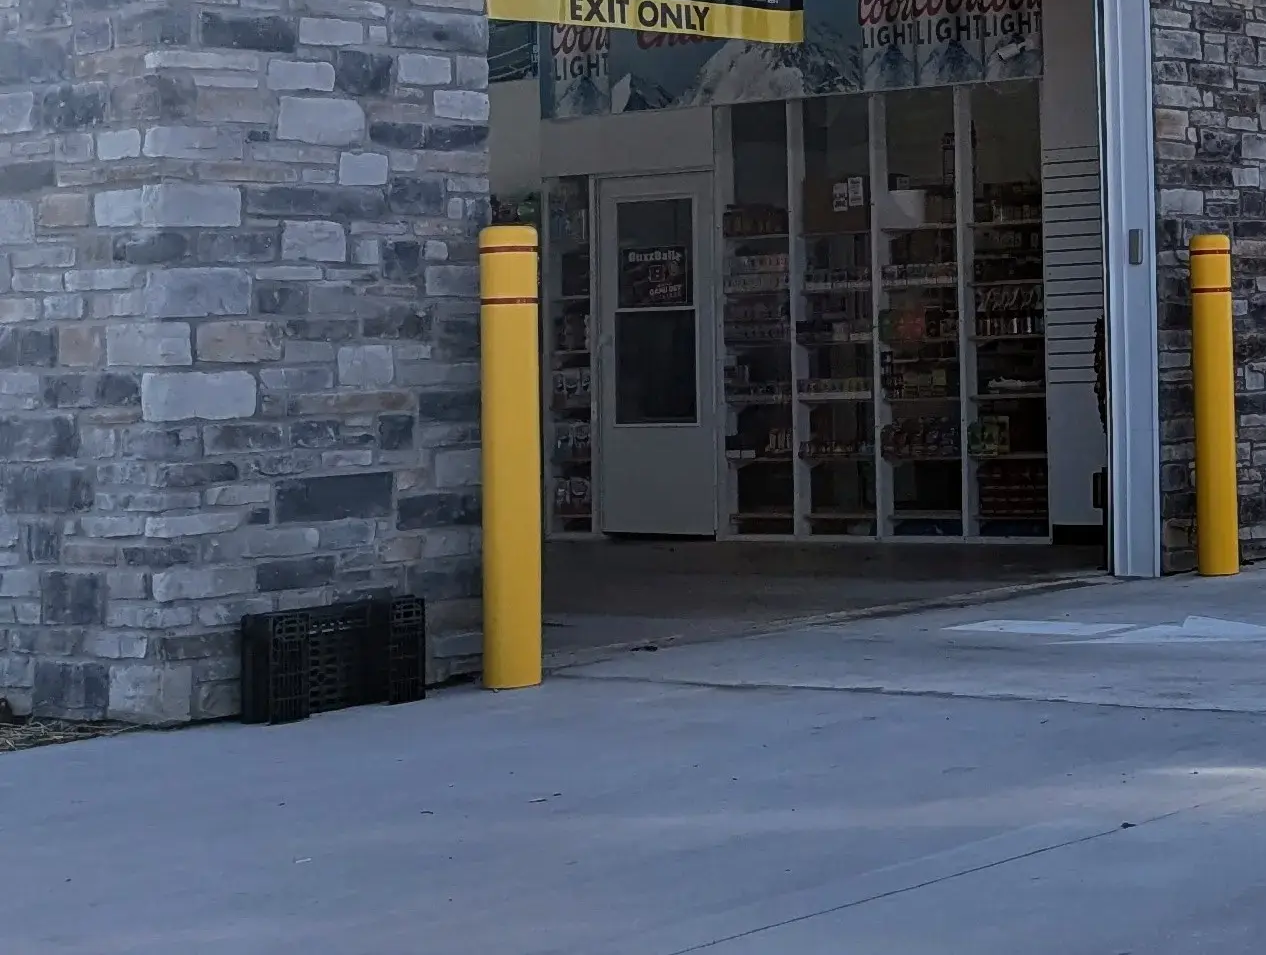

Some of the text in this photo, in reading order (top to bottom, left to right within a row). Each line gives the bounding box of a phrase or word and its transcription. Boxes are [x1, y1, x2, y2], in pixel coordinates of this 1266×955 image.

[637, 0, 710, 31] ONLY
[915, 14, 984, 44] LIGHT
[982, 10, 1042, 38] LIGHT
[861, 23, 913, 48] LIGHT
[553, 52, 609, 81] LIGHT
